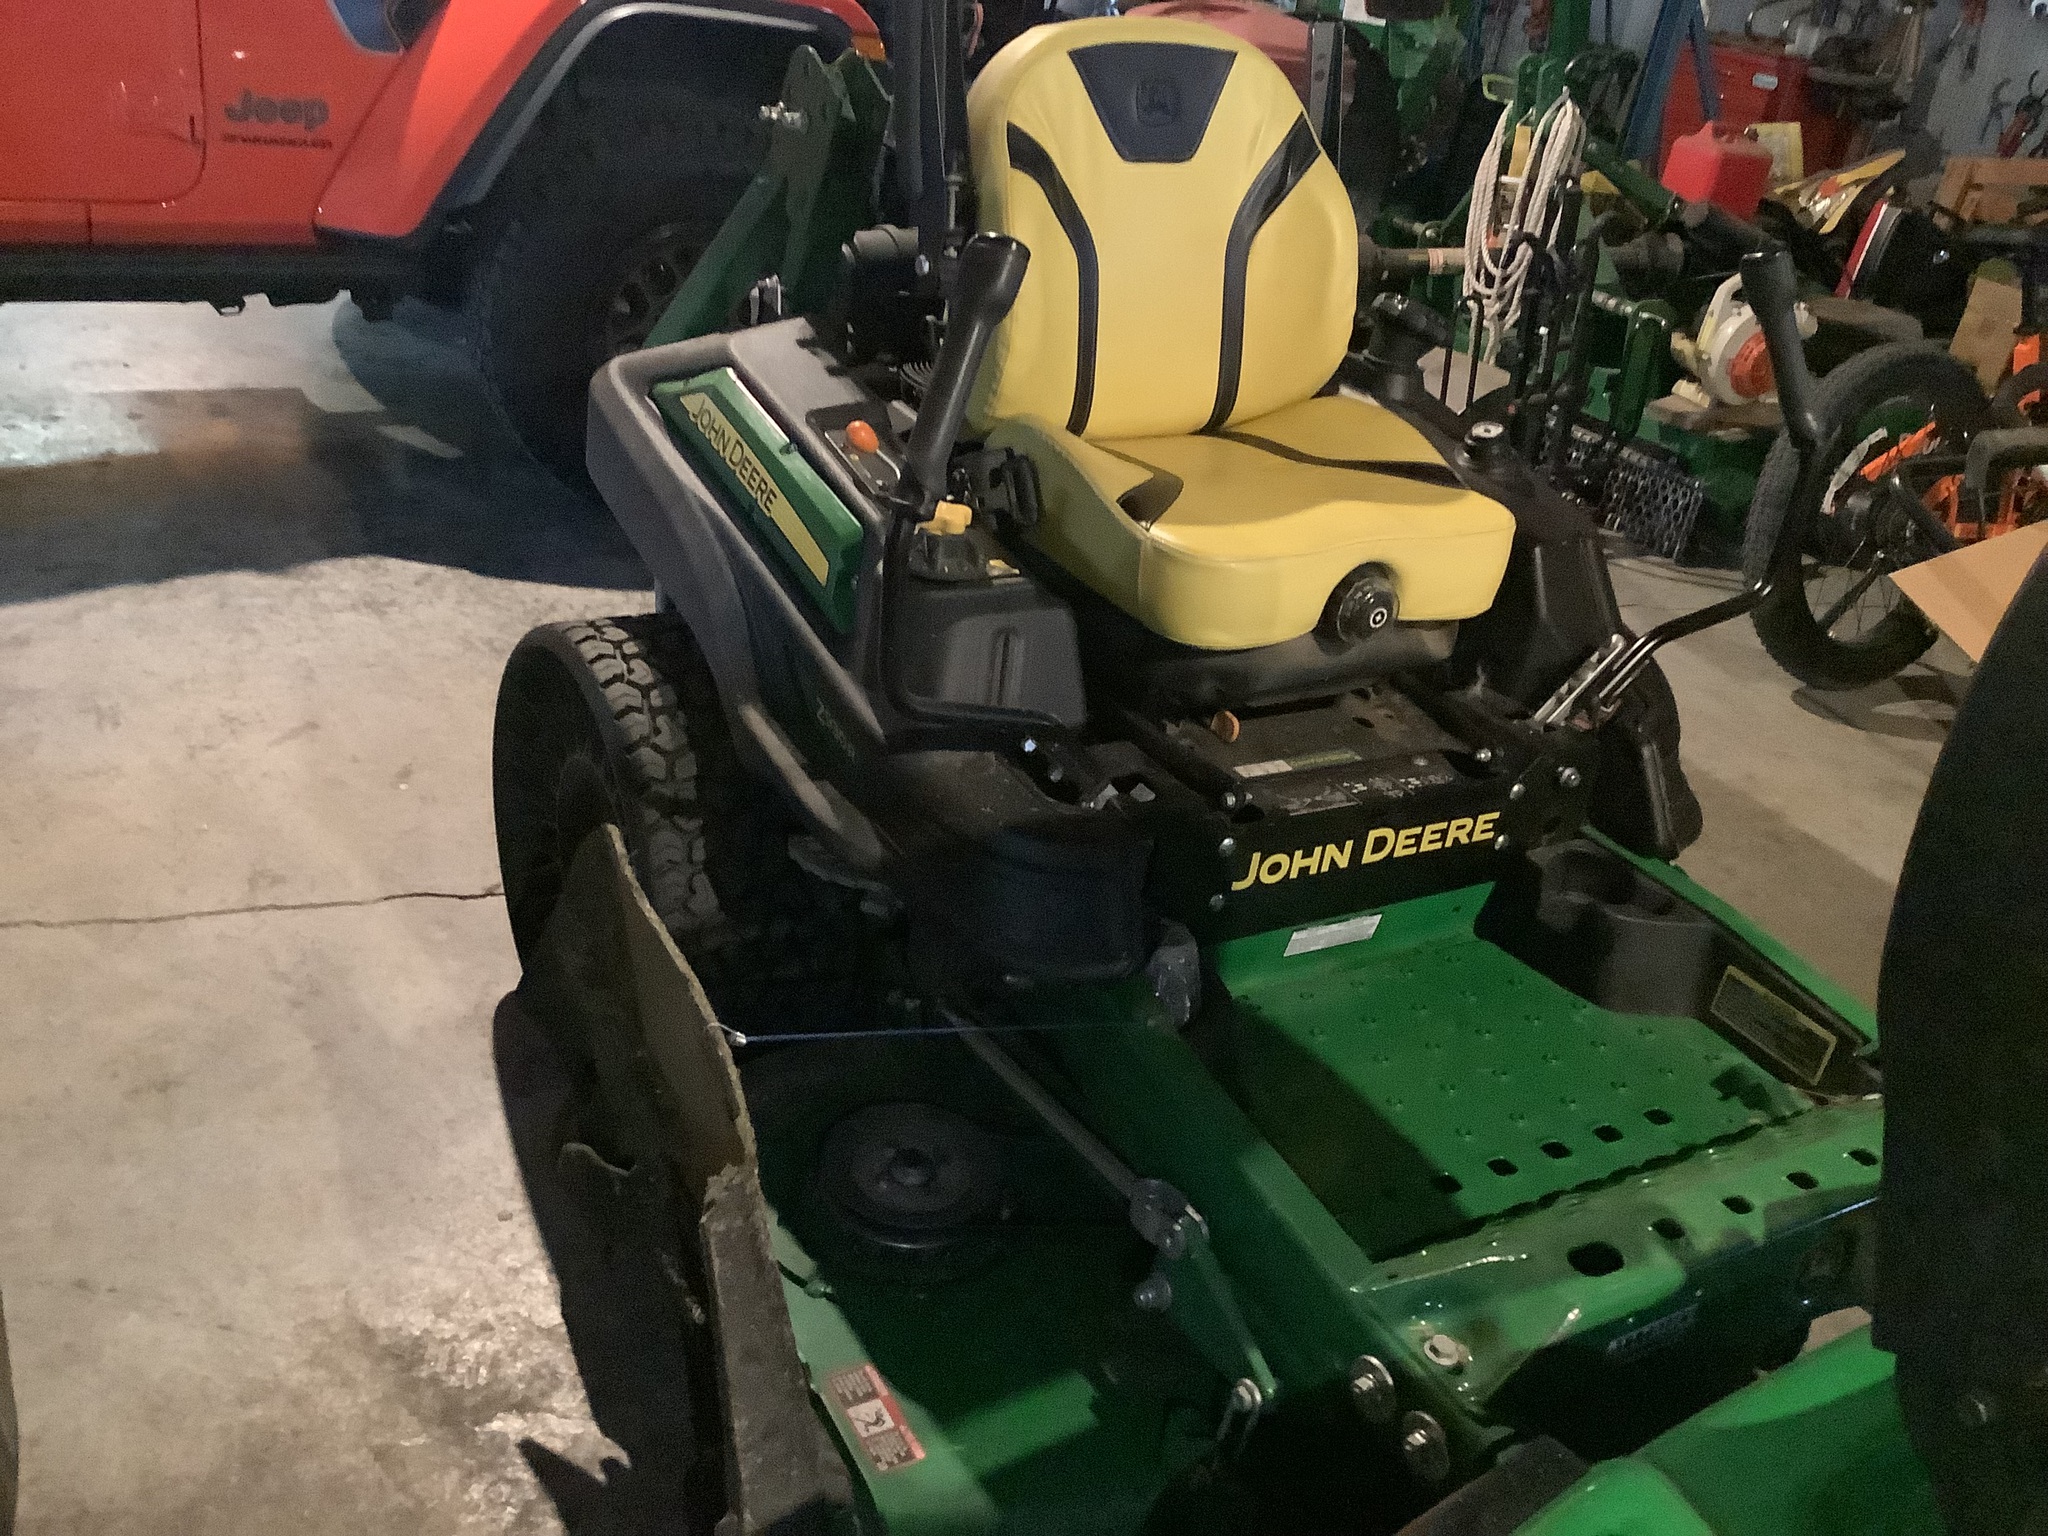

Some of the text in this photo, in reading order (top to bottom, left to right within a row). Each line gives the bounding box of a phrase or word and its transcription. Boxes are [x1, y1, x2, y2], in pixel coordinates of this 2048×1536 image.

[223, 88, 330, 133] Jeep
[691, 399, 778, 514] JOHN DEERE
[1231, 811, 1501, 891] JOHN DEERE
